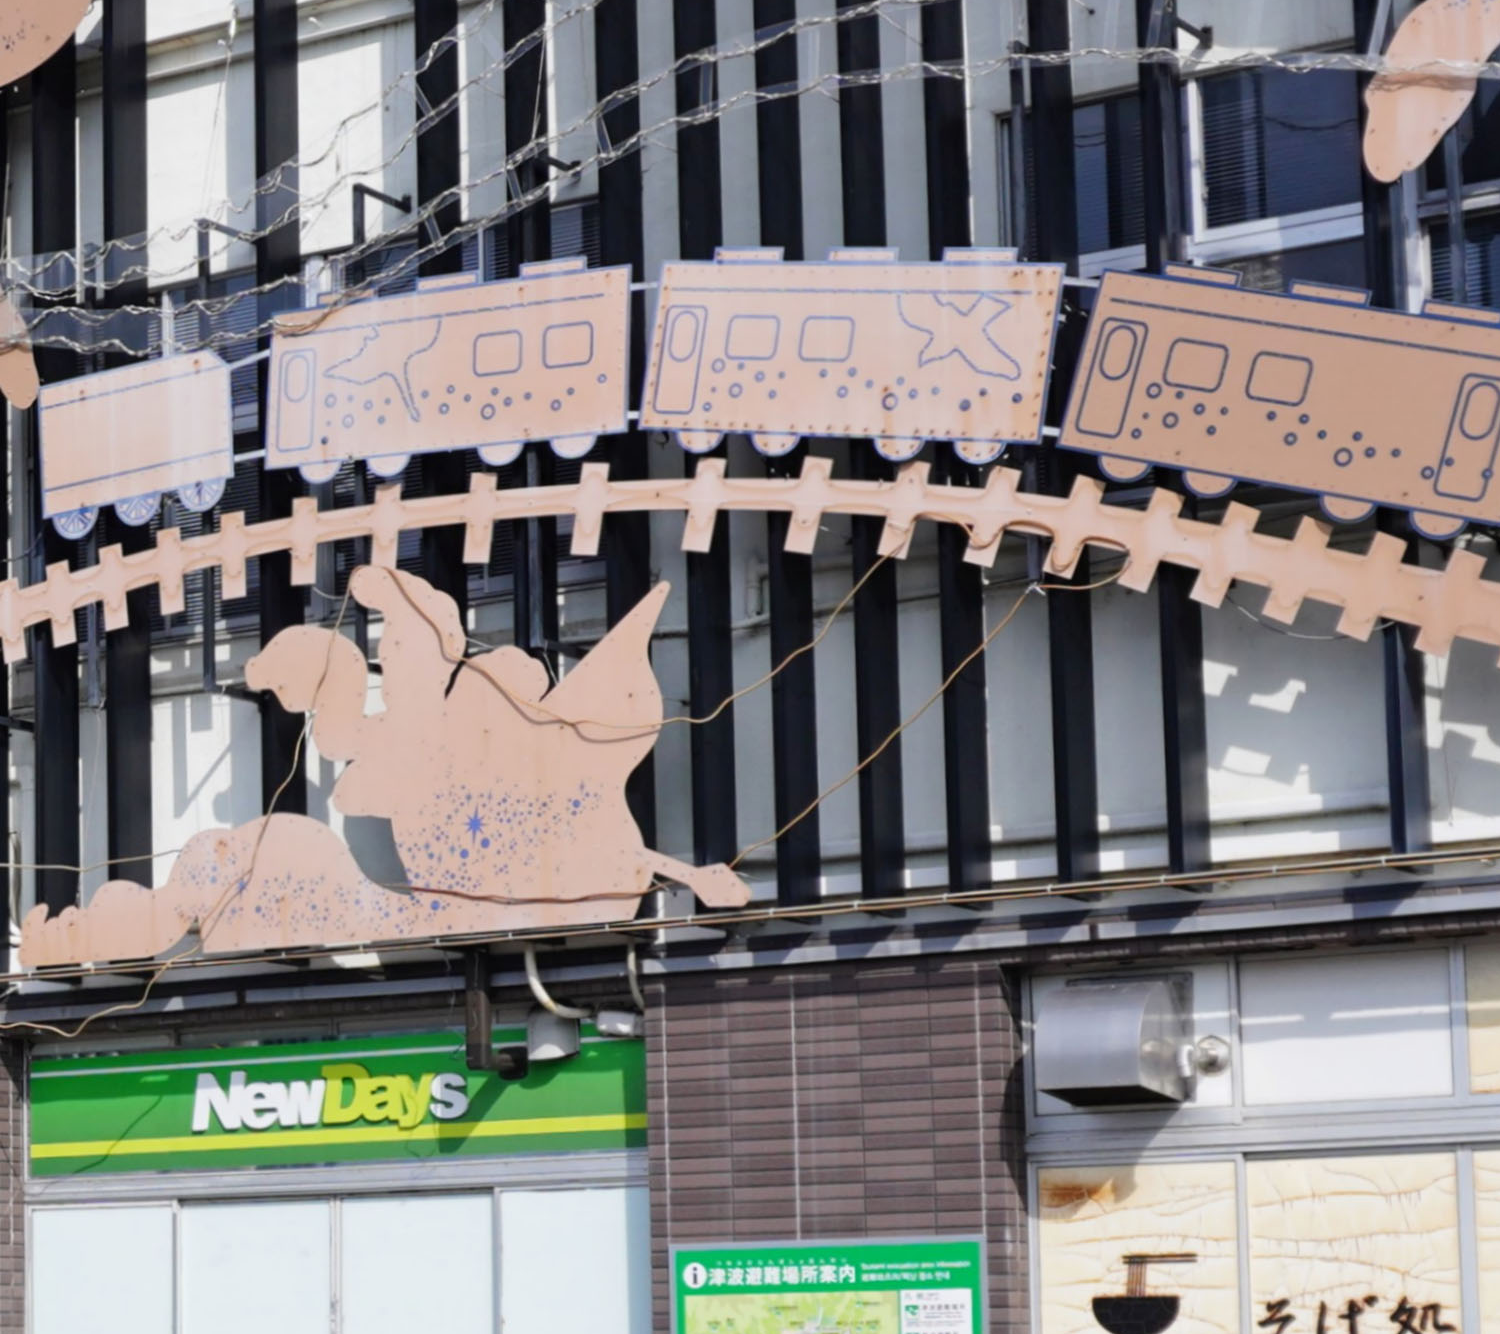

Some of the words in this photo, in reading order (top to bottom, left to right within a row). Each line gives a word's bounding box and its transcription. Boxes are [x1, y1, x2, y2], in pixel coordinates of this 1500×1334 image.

[191, 1063, 469, 1131] NewDays
[708, 1265, 857, 1286] 津波避難場所案内
